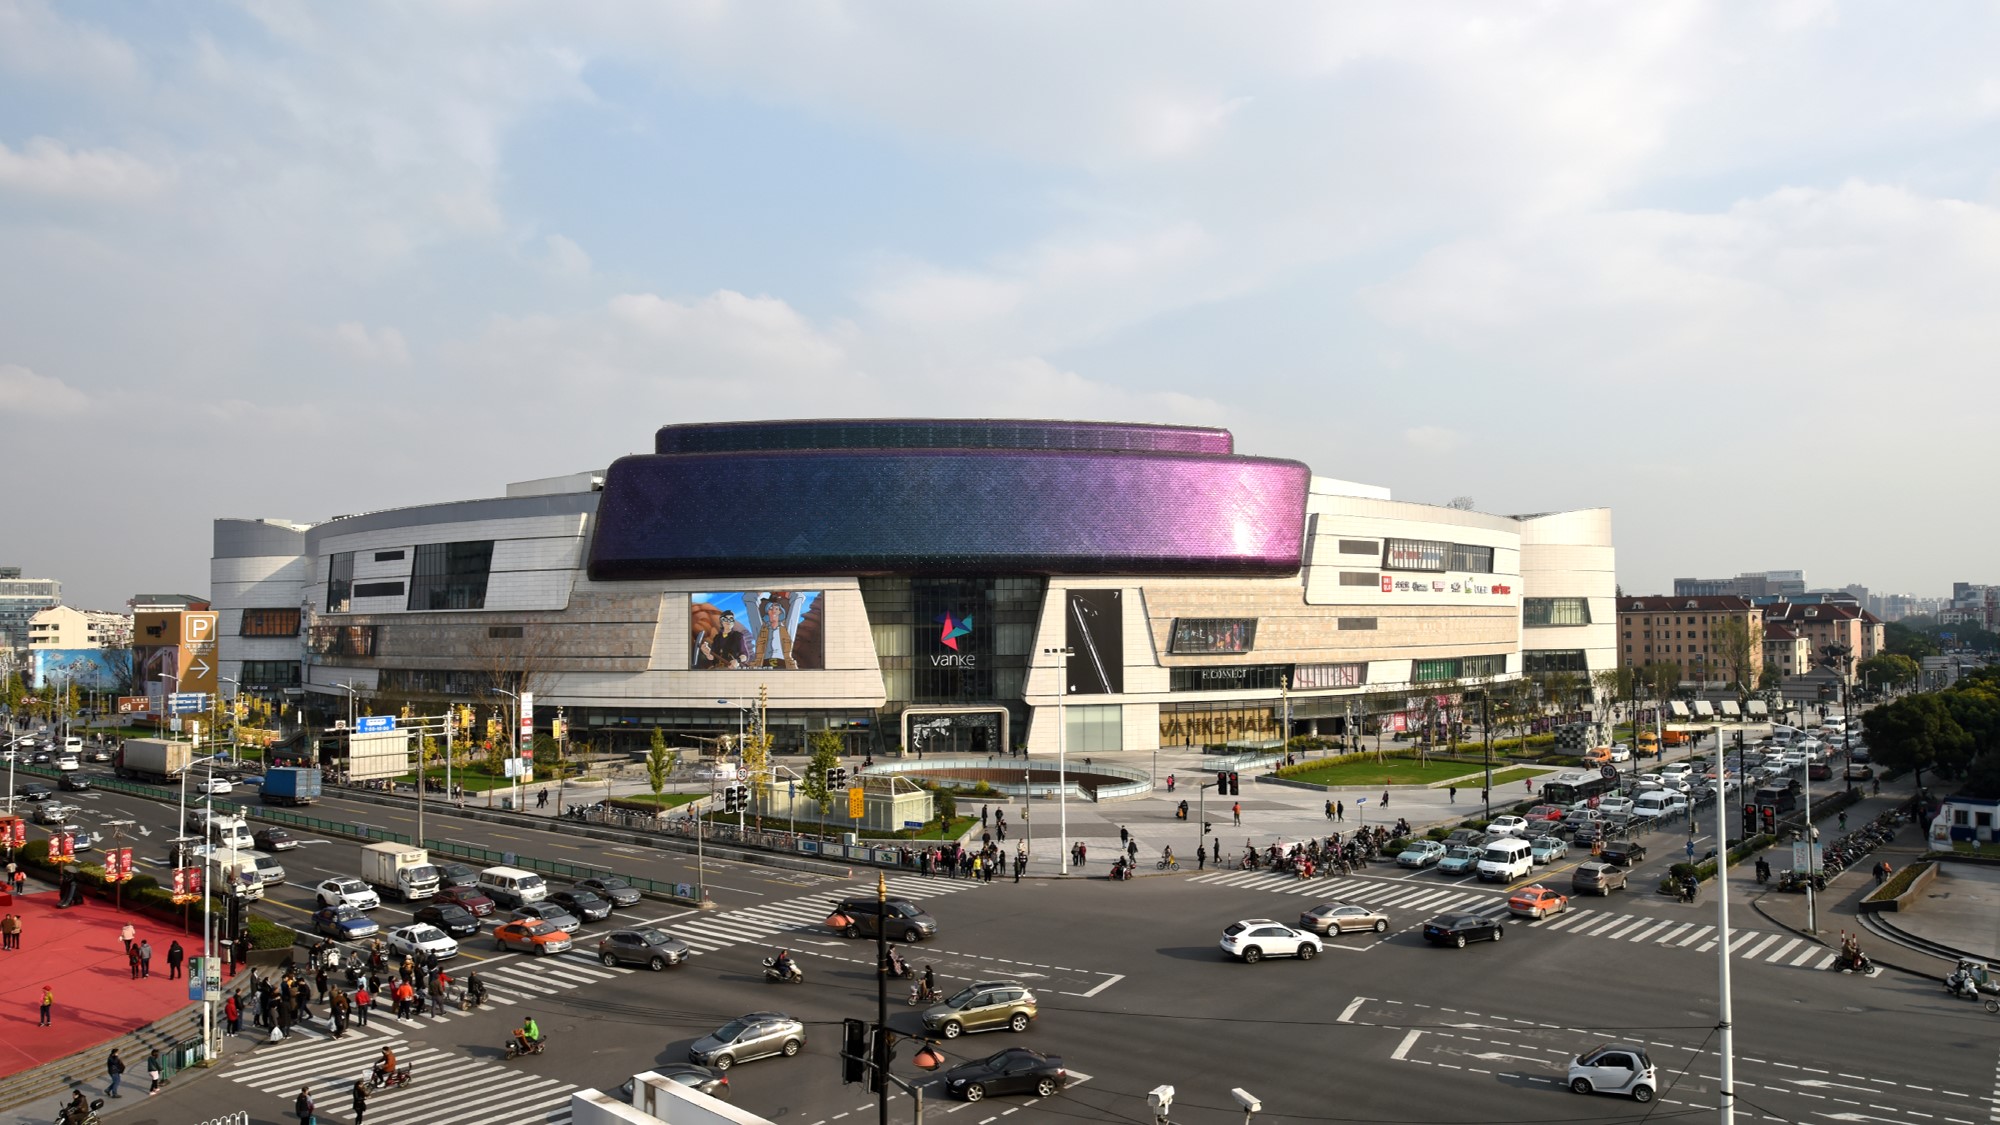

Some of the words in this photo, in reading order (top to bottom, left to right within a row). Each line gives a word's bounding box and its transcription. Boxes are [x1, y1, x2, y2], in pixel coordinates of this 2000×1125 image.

[193, 619, 208, 638] P
[930, 654, 976, 667] vanke
[1604, 768, 1614, 776] 50
